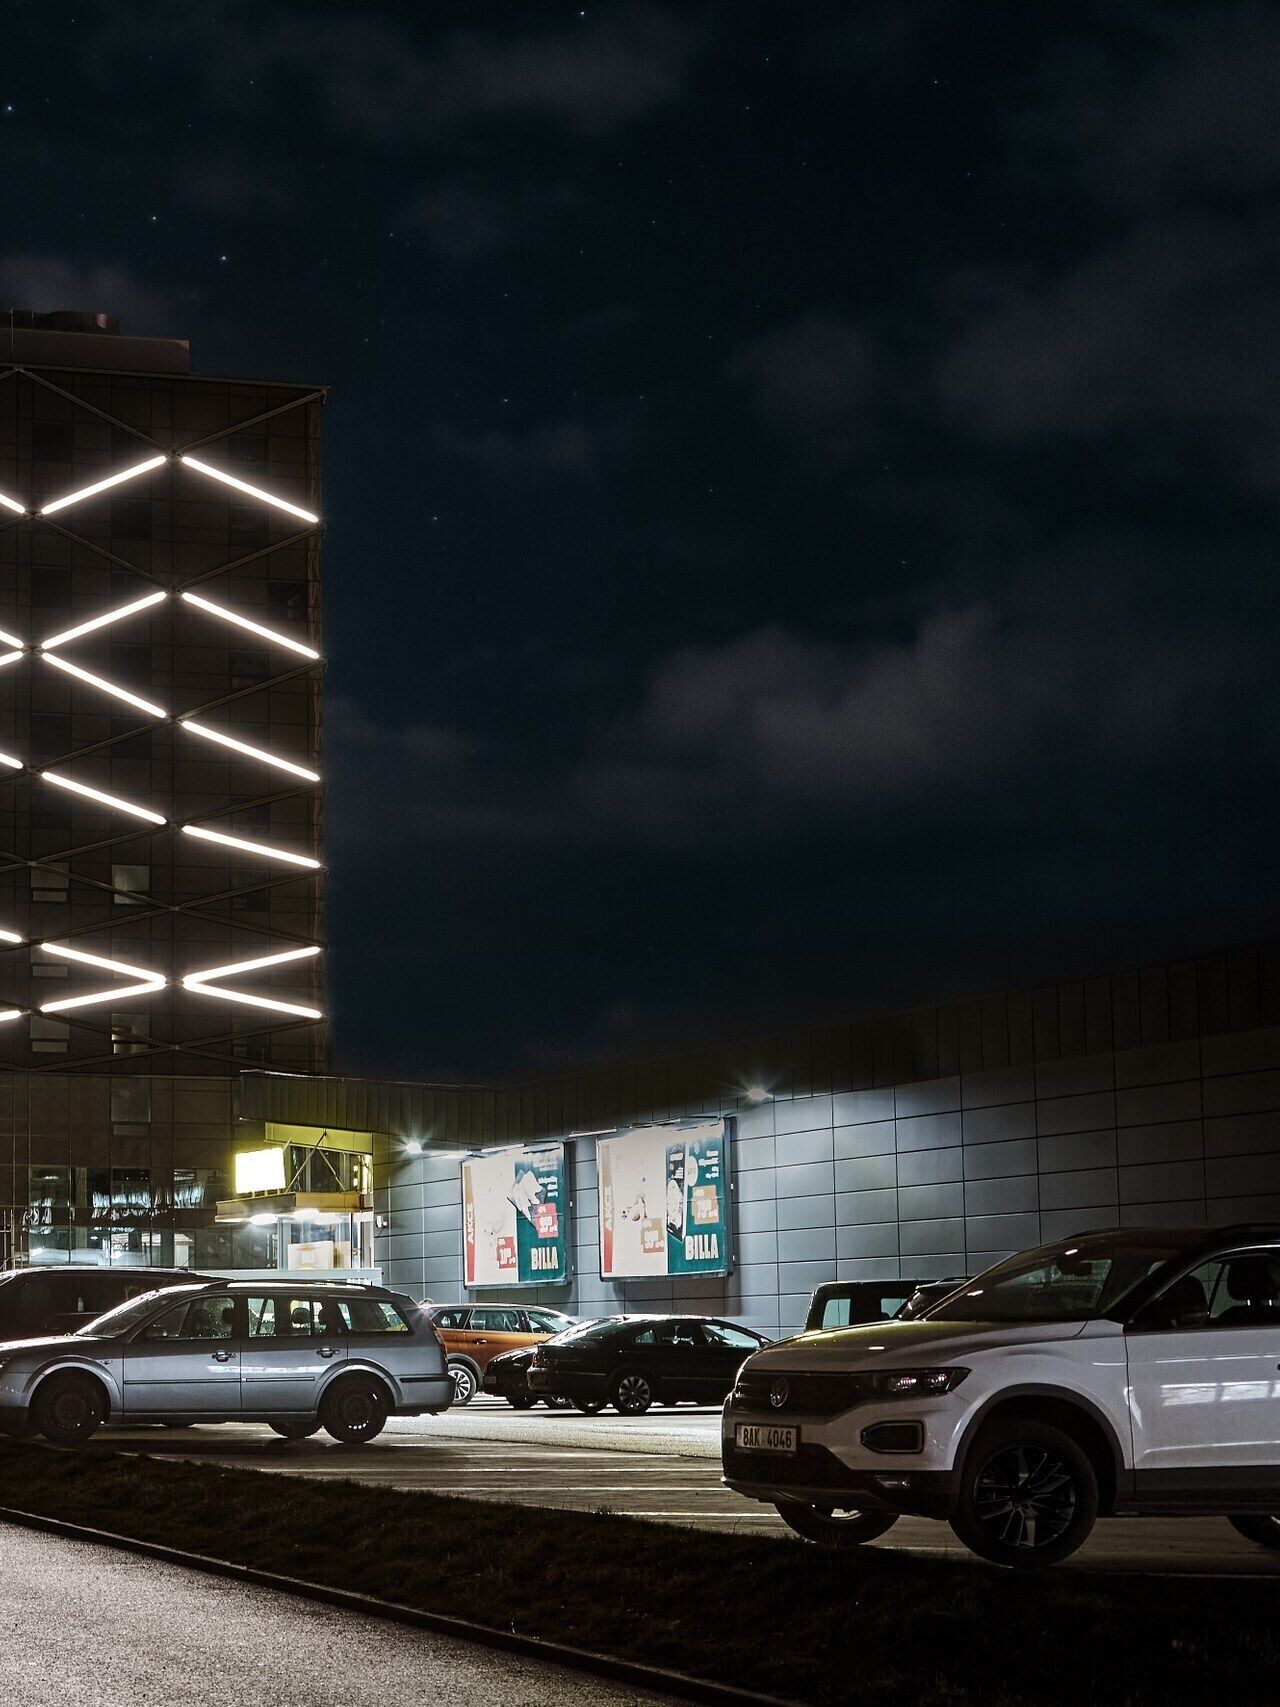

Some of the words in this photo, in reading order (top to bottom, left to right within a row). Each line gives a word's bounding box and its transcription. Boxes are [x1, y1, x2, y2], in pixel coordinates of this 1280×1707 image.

[530, 1246, 559, 1271] BILLA
[685, 1233, 719, 1261] BILLA
[743, 1427, 760, 1447] 8AK
[767, 1429, 792, 1449] 4046
